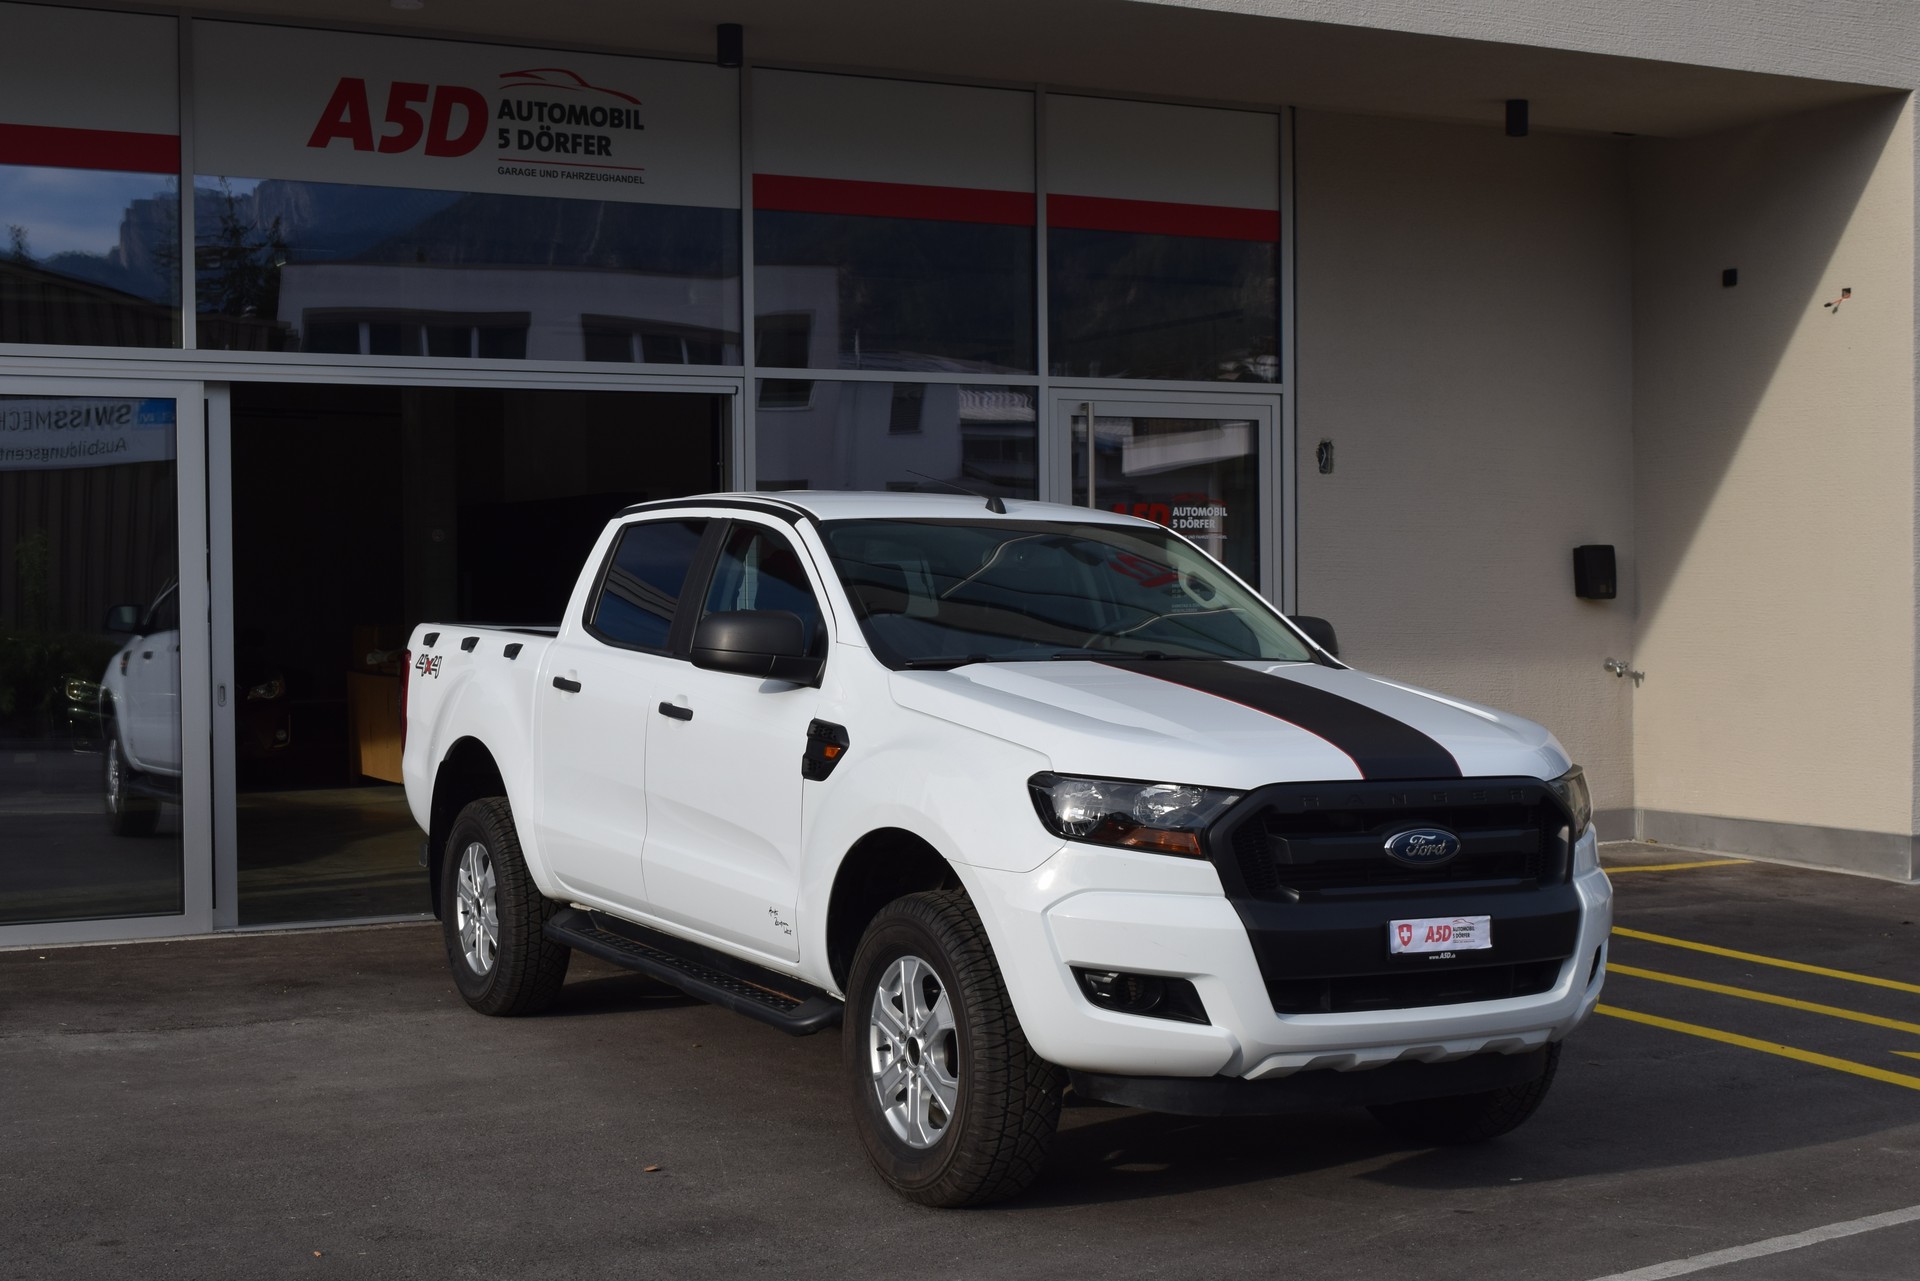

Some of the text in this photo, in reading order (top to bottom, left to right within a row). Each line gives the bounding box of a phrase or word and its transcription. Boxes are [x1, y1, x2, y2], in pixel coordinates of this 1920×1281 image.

[306, 77, 489, 158] A5D
[498, 98, 645, 131] AUTOMOBIL
[498, 125, 612, 157] 5 DÖRFER
[497, 166, 646, 185] GARAGE UND FAHRZEUGHANDEL
[1172, 507, 1228, 517] AUTOMOBIL
[1172, 517, 1216, 529] 5 DÖRFER
[1405, 834, 1447, 857] Ford
[1425, 926, 1452, 942] A5D
